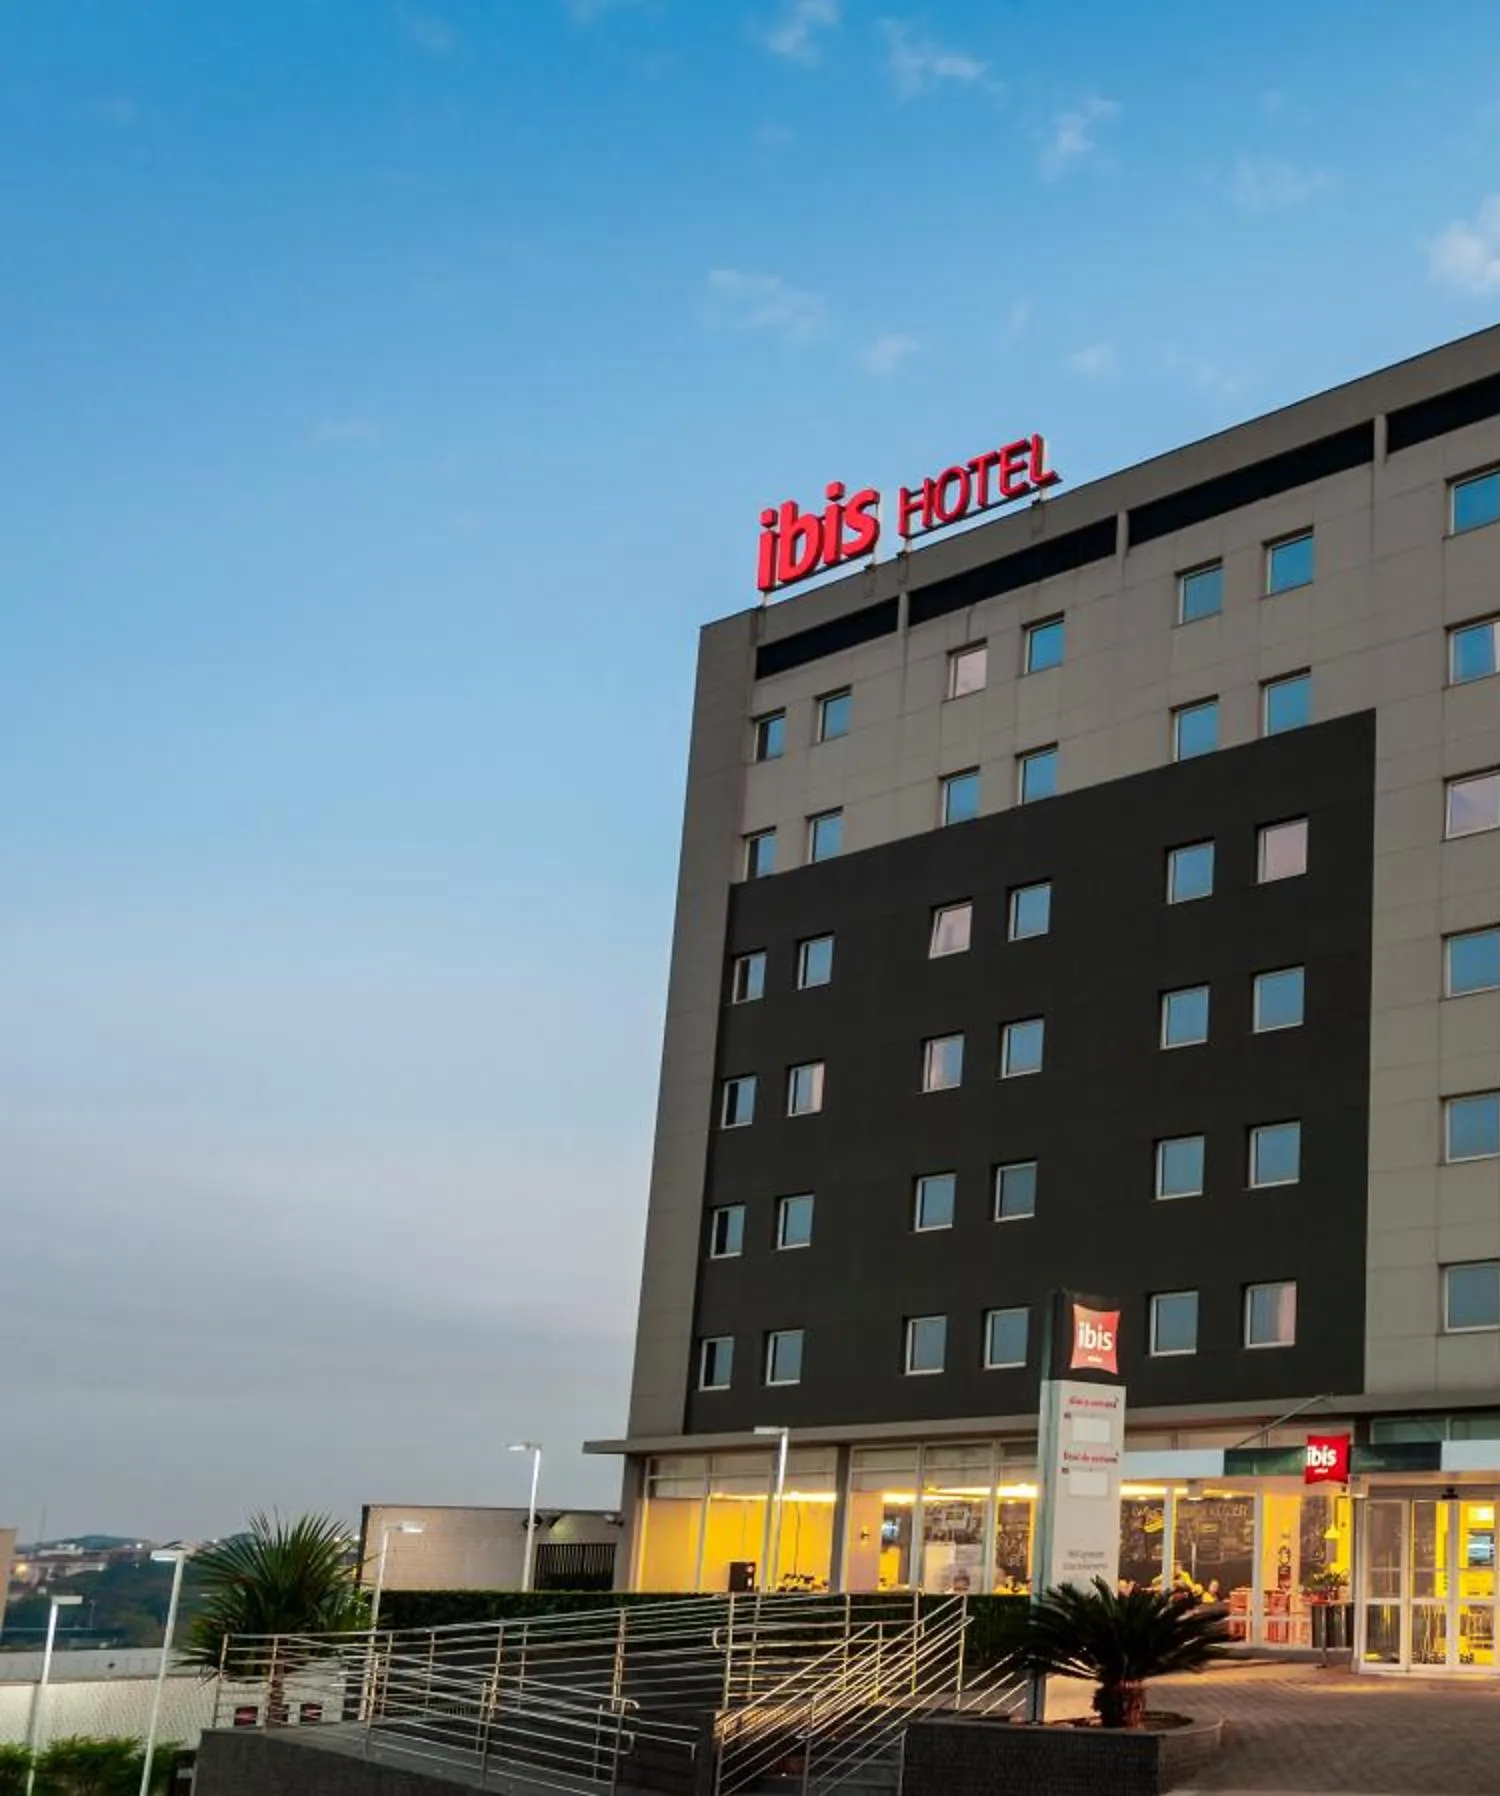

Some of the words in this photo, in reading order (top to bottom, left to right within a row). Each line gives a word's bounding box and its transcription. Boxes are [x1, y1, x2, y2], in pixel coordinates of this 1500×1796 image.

[757, 481, 880, 591] ibis
[898, 432, 1062, 538] HOTEL
[1077, 1321, 1114, 1352] ibis
[1306, 1445, 1337, 1467] ibis
